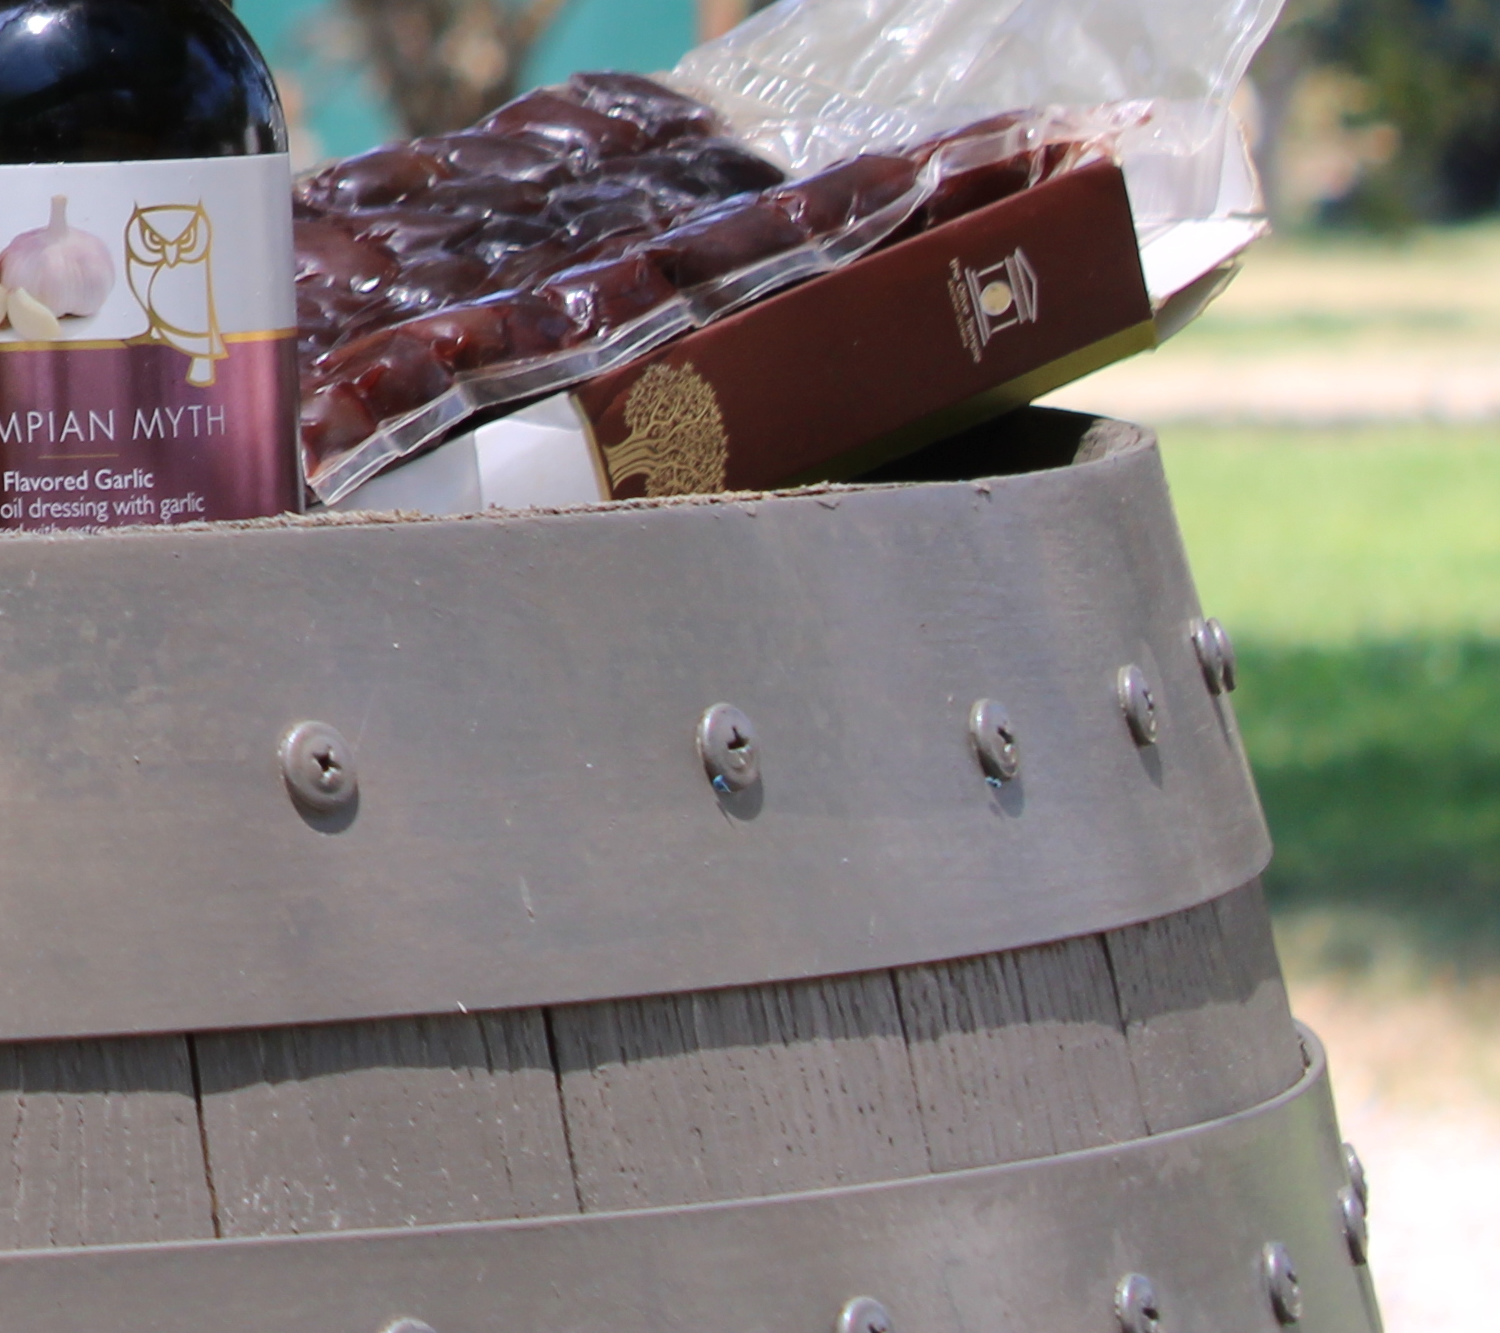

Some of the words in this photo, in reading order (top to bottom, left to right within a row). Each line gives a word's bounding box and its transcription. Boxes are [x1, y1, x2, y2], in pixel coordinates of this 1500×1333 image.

[132, 405, 226, 442] MYTH
[3, 470, 89, 493] Flavored
[94, 469, 154, 490] Garlic
[0, 497, 24, 519] oil
[28, 492, 110, 524] dressing
[114, 494, 155, 517] with
[160, 493, 205, 522] garlic
